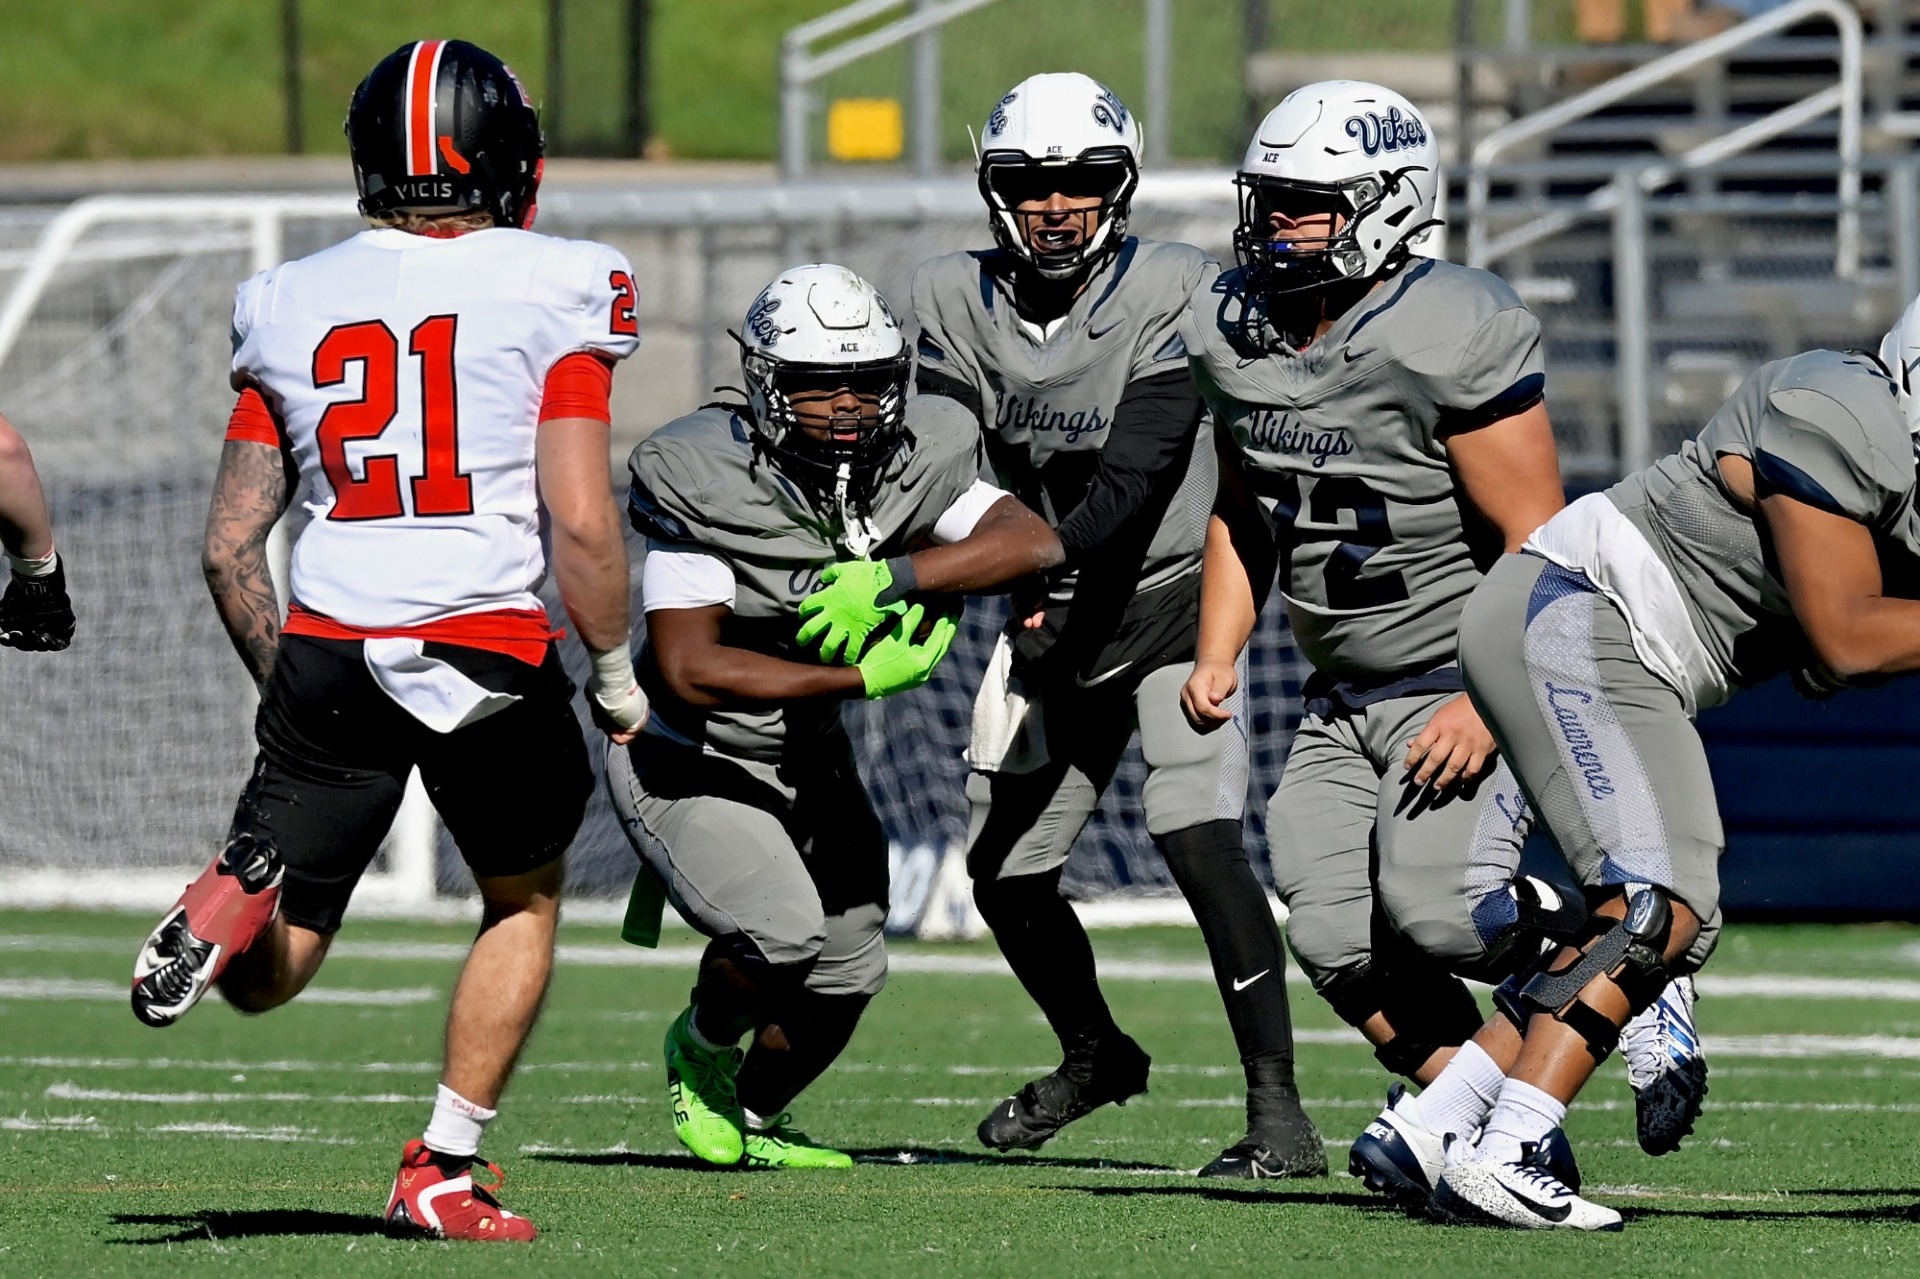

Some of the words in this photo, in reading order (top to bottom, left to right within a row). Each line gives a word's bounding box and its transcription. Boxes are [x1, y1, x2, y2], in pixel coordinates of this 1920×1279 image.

[1046, 146, 1063, 154] ACE
[1262, 152, 1280, 164] ACE
[1344, 106, 1428, 158] Vikes
[394, 182, 453, 200] VICIS
[608, 270, 640, 337] 2
[840, 343, 859, 353] ACE
[311, 313, 475, 522] 21
[996, 390, 1109, 443] Vikings
[1249, 410, 1355, 469] Vikings
[1545, 681, 1616, 800] Lawrence
